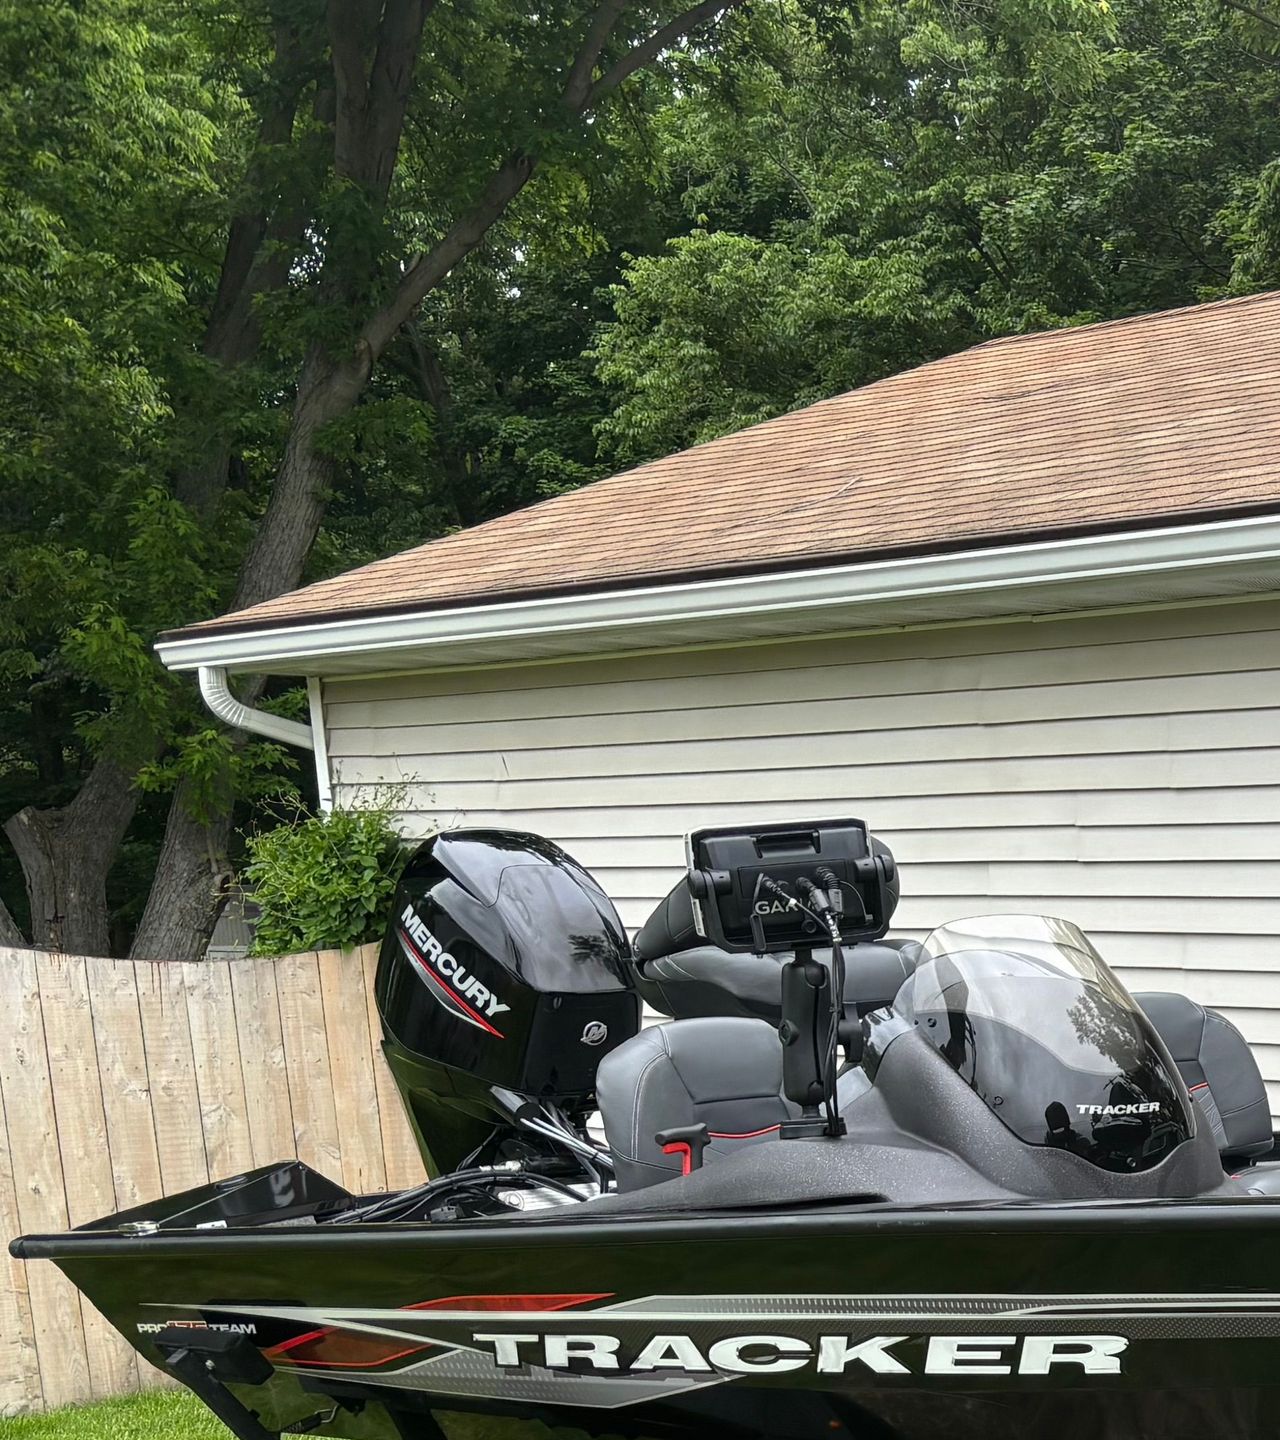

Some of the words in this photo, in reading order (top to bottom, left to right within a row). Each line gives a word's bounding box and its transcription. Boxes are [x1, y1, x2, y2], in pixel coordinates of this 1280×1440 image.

[401, 904, 511, 1017] MERCURY
[1076, 1102, 1160, 1115] TRACKER
[472, 1333, 1129, 1375] TRACKER
